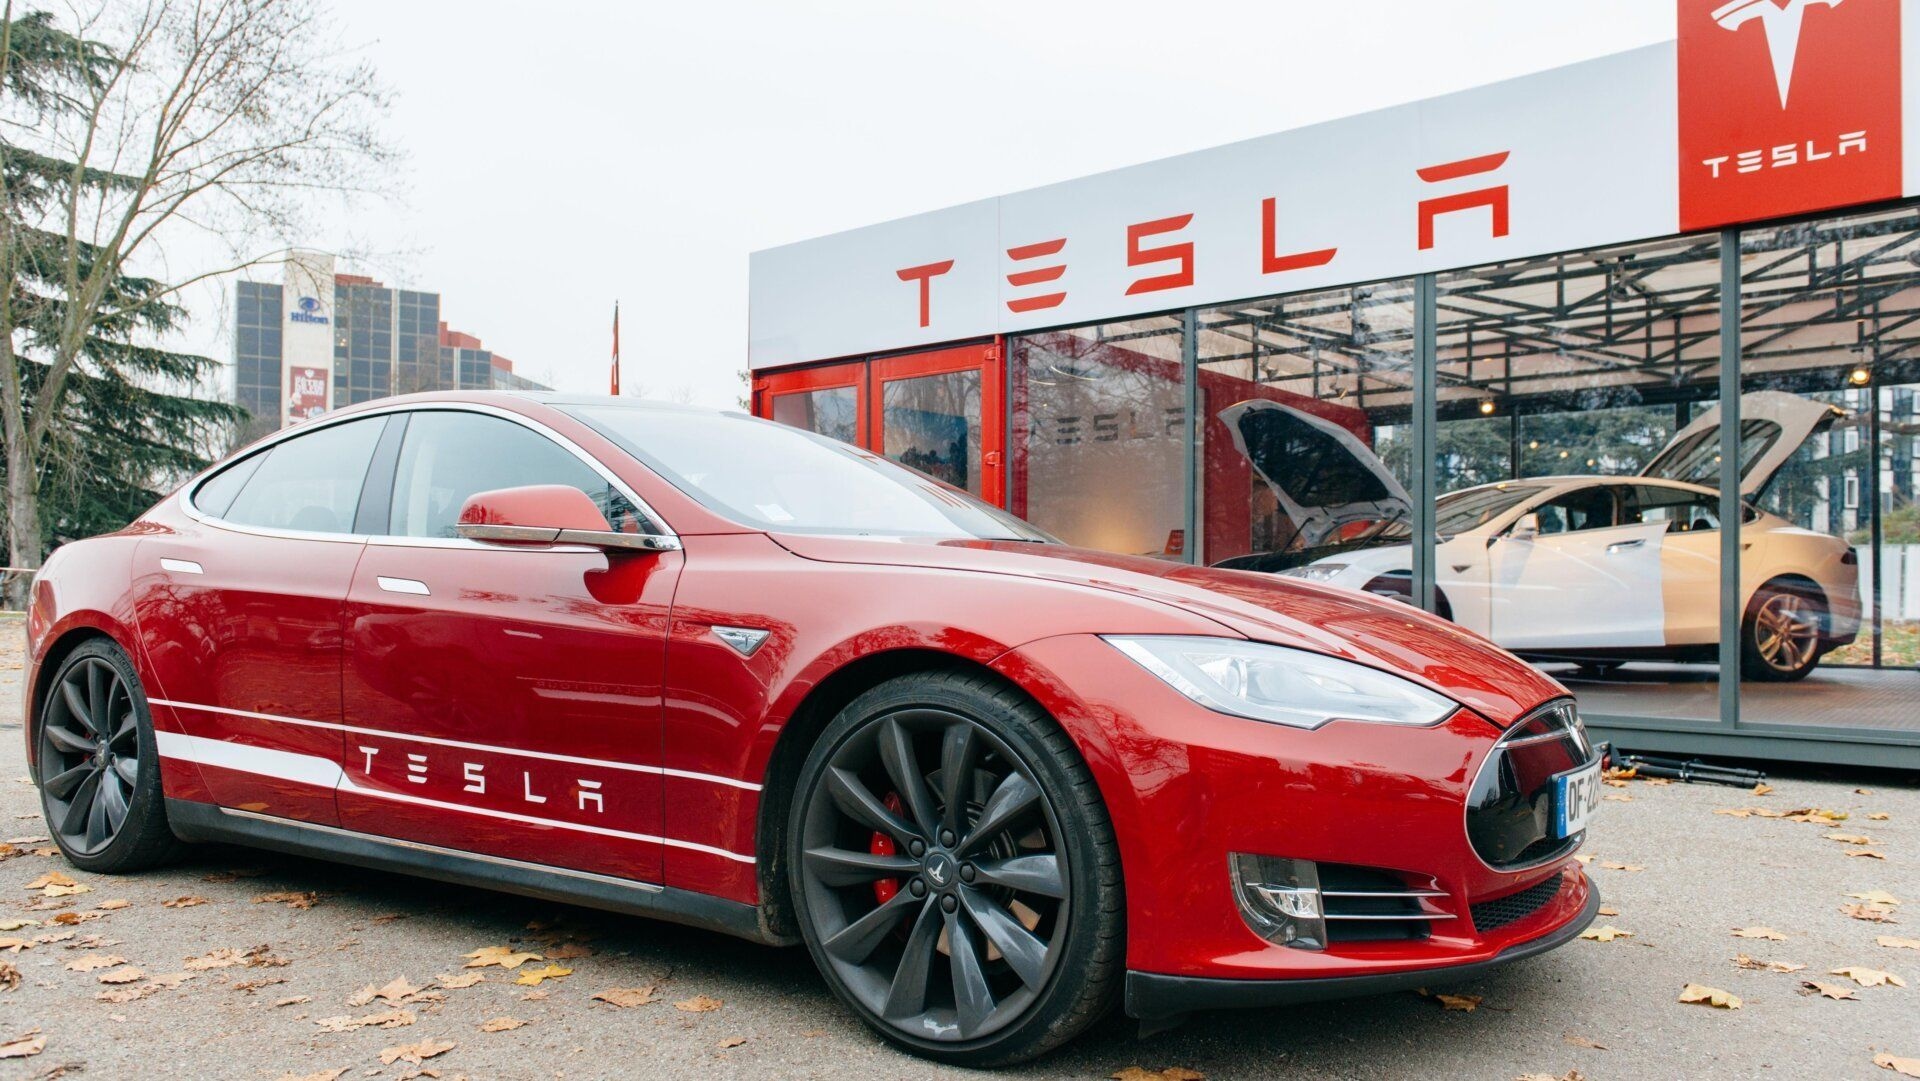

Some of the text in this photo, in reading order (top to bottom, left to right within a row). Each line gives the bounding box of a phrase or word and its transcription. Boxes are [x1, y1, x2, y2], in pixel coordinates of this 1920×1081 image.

[1702, 130, 1867, 178] TESLA
[897, 151, 1510, 327] TESLA
[291, 310, 329, 325] Hilton
[358, 745, 604, 813] TESLA
